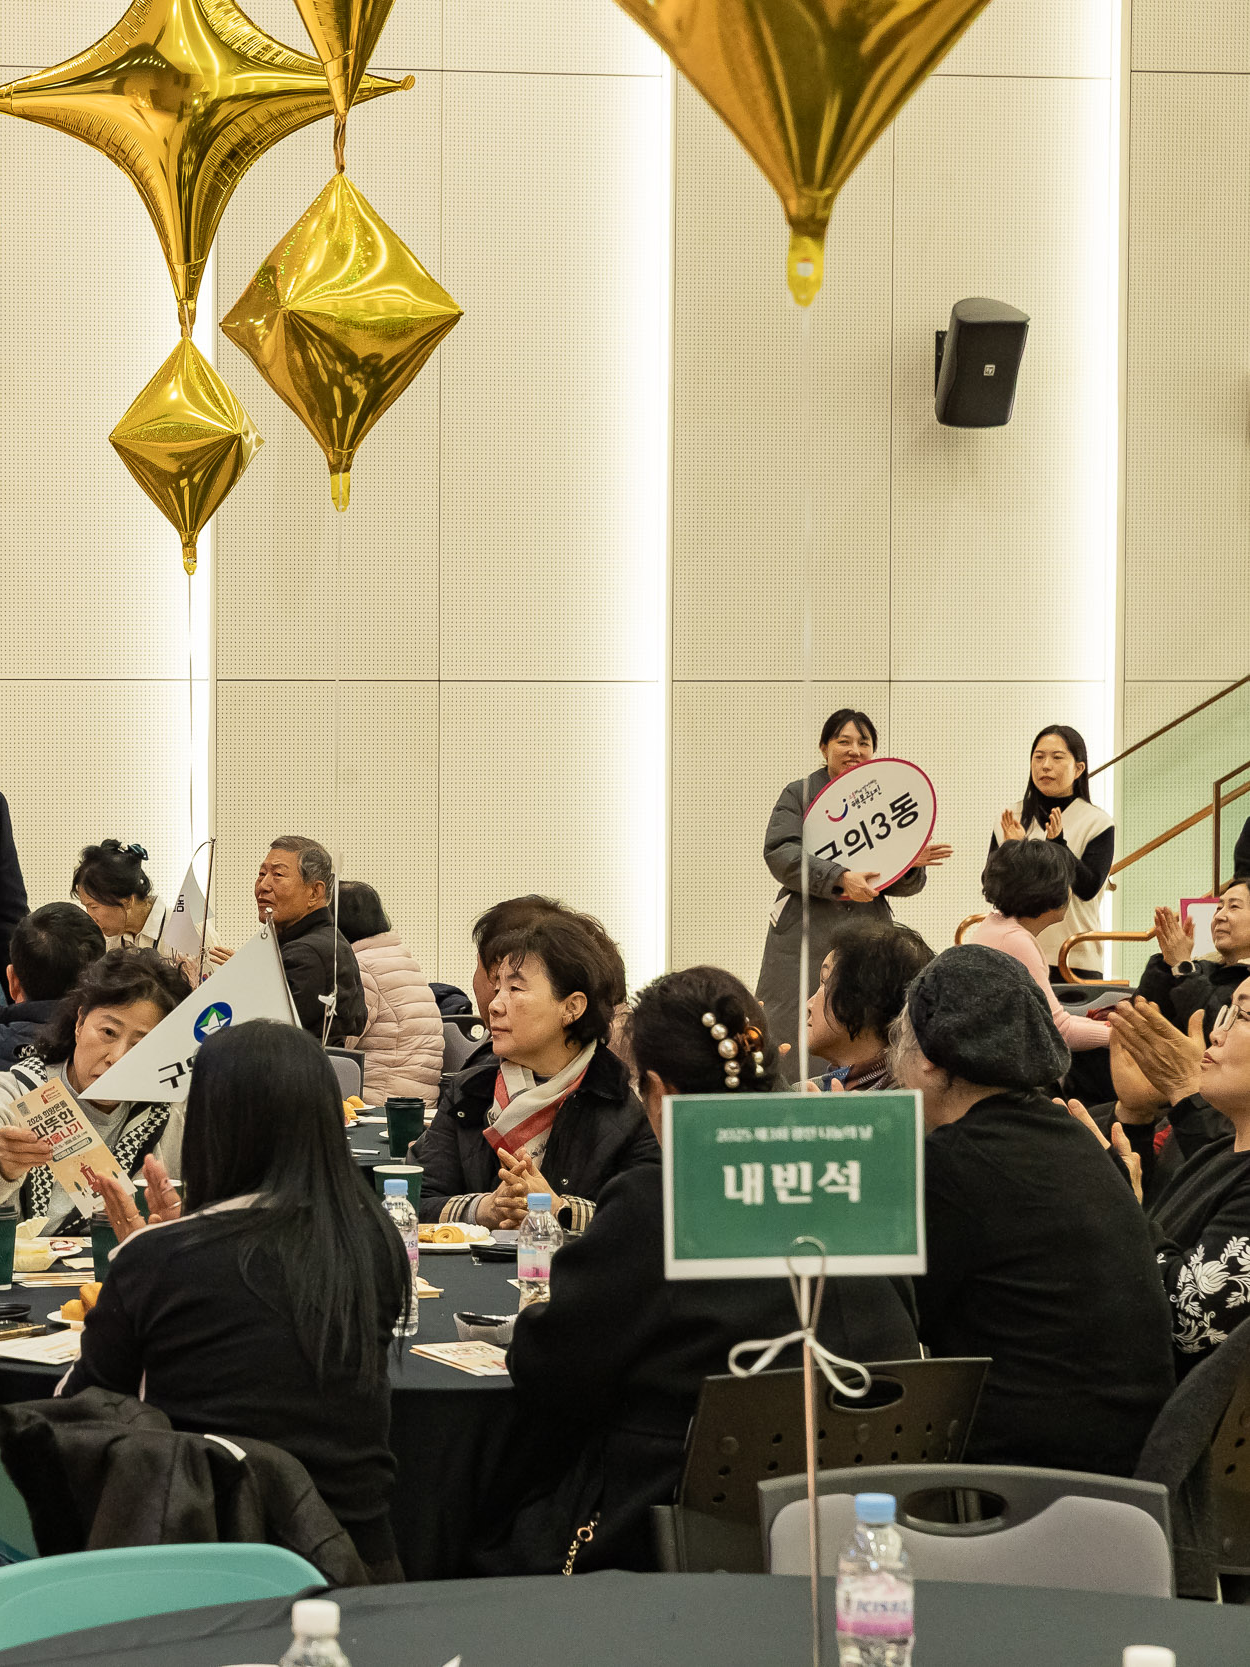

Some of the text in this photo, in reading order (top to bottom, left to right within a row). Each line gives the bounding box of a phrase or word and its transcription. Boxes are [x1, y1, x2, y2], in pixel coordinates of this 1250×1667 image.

[814, 791, 919, 861] 구의3동
[26, 1114, 43, 1126] 2026
[31, 1107, 77, 1140] 따뜻한
[722, 1160, 861, 1206] 내빈석
